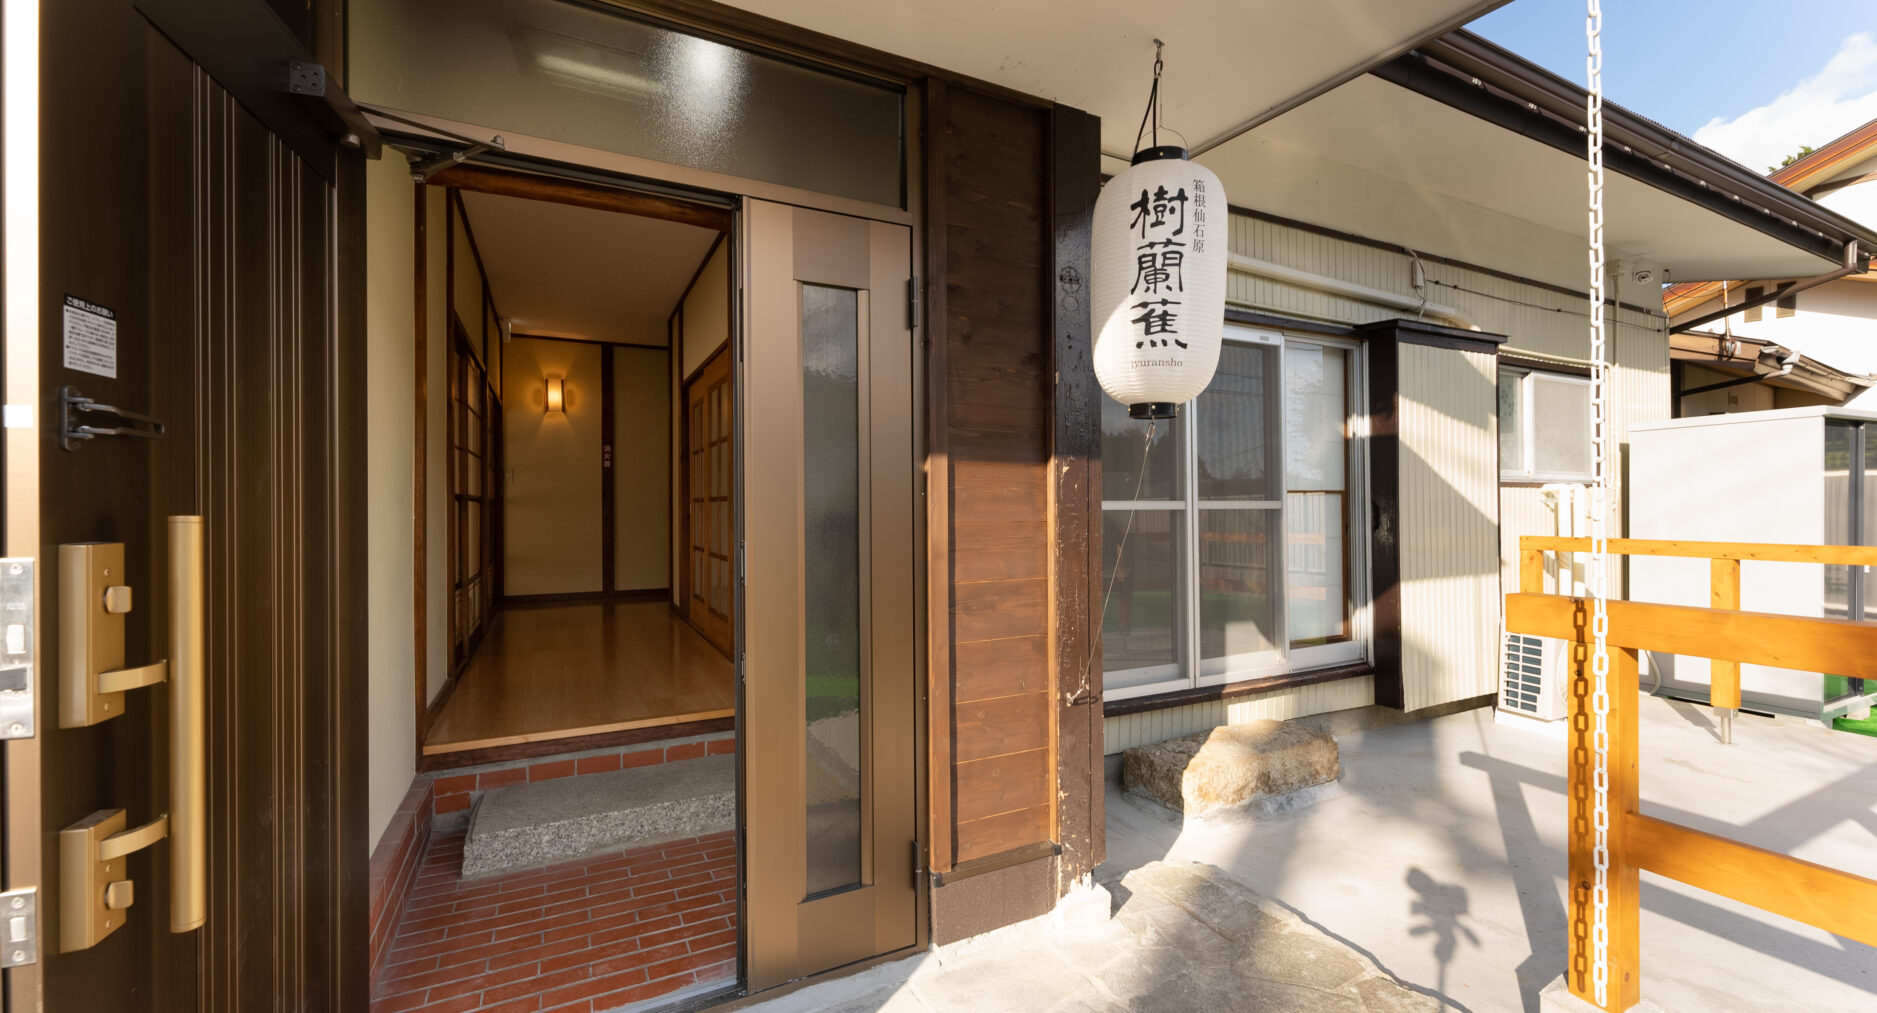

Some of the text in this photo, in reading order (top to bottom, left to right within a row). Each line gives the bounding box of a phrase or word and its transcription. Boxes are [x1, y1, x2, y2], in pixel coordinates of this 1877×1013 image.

[1192, 179, 1206, 253] 箱根仙石原
[1130, 185, 1188, 349] 樹蘭蕉
[66, 296, 114, 318] ご使用上のお願い
